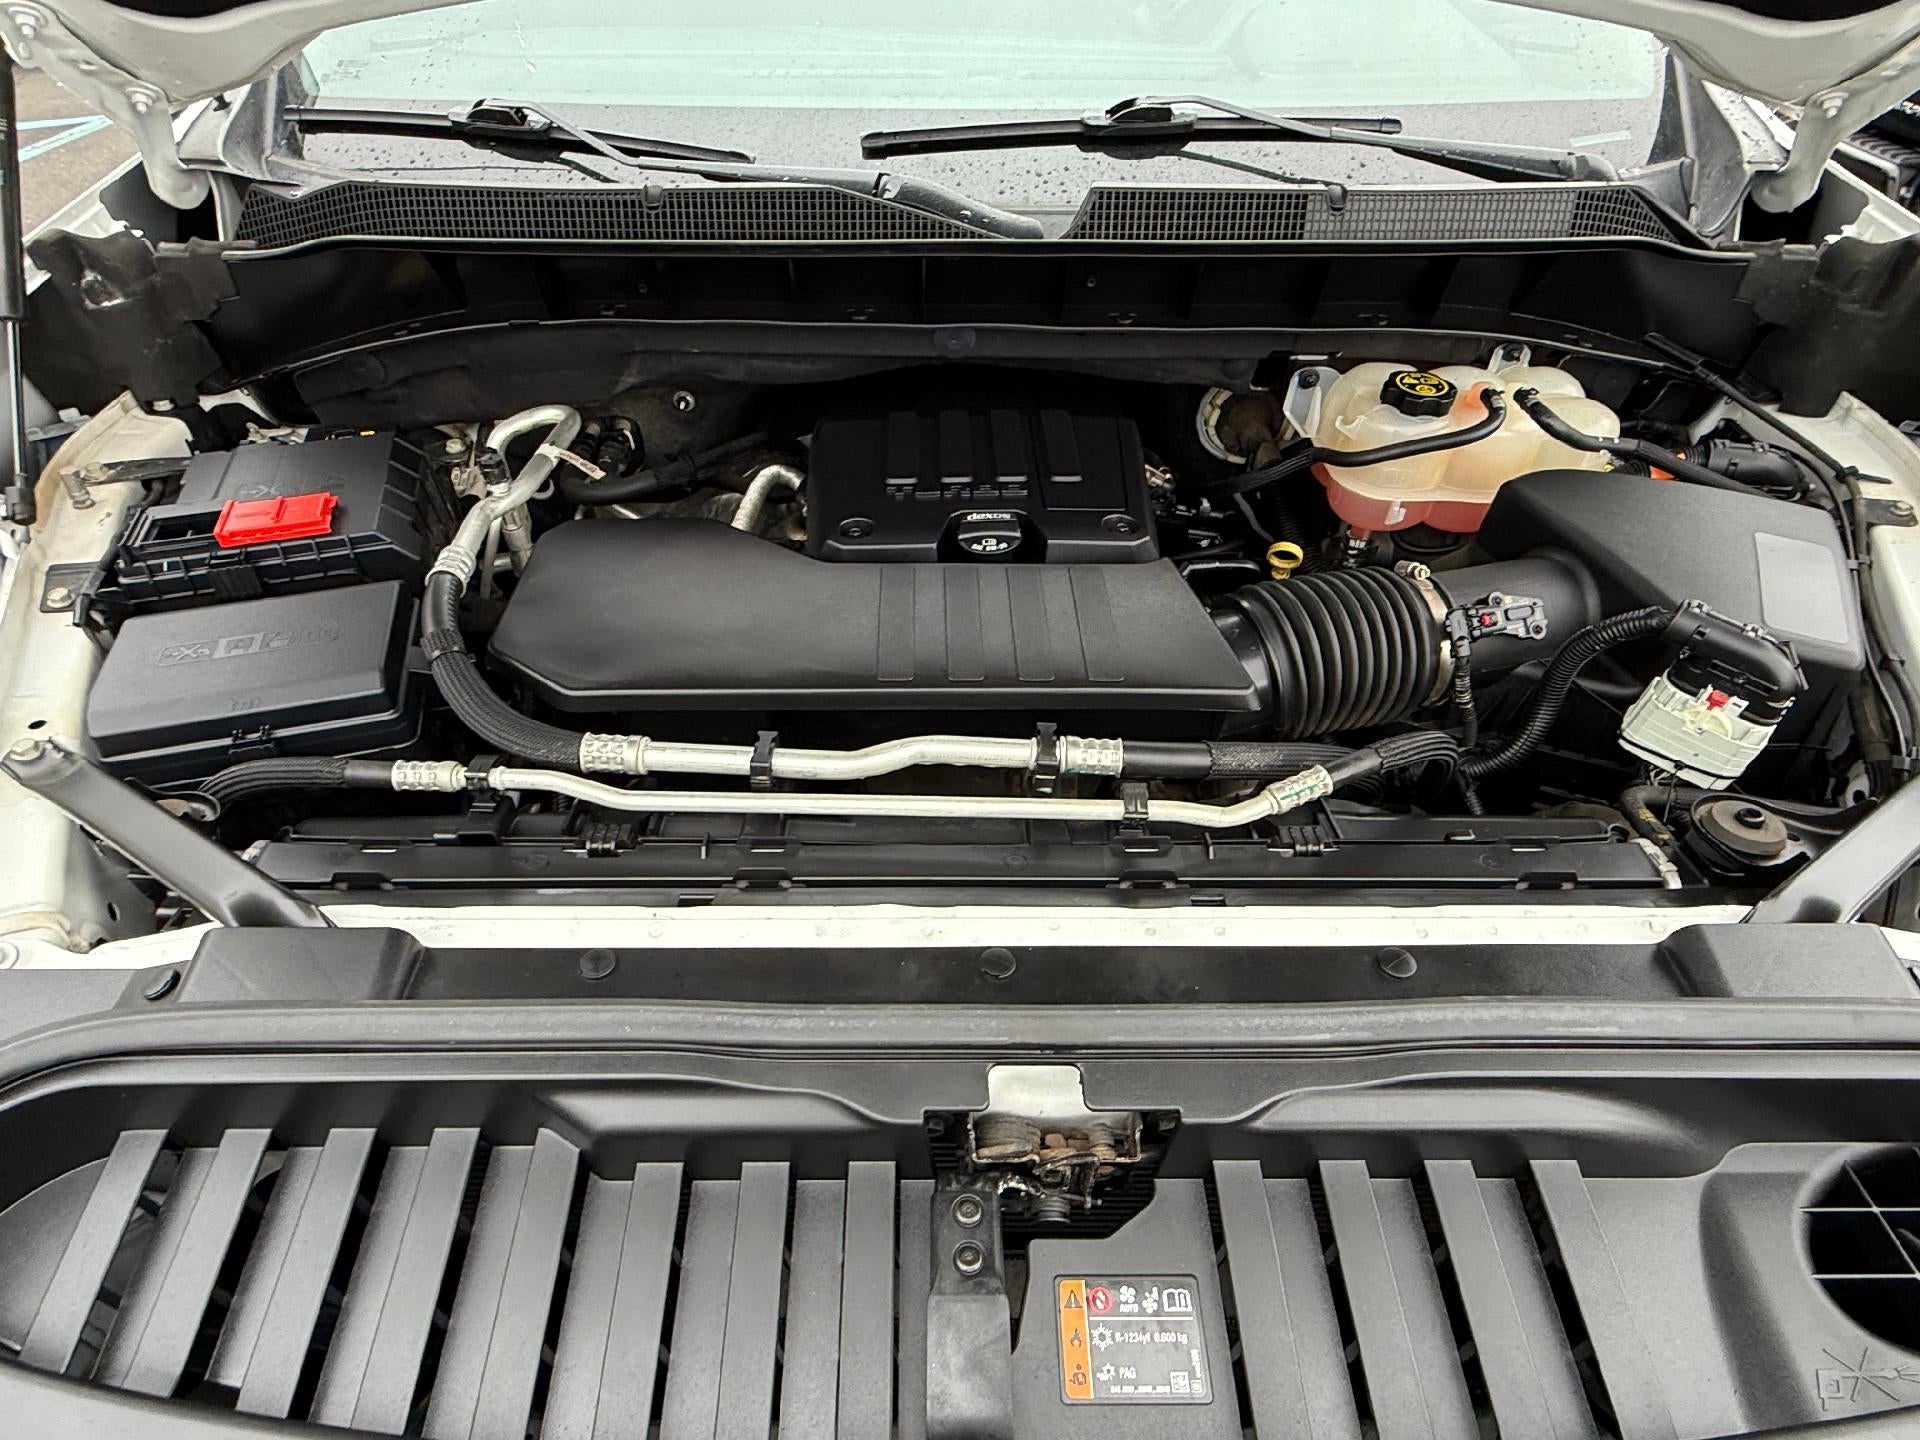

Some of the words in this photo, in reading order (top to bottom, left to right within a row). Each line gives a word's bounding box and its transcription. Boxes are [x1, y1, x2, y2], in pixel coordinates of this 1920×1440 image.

[1120, 1304, 1139, 1313] AUTO
[1177, 1332, 1188, 1345] kg
[1119, 1366, 1137, 1379] PAG
